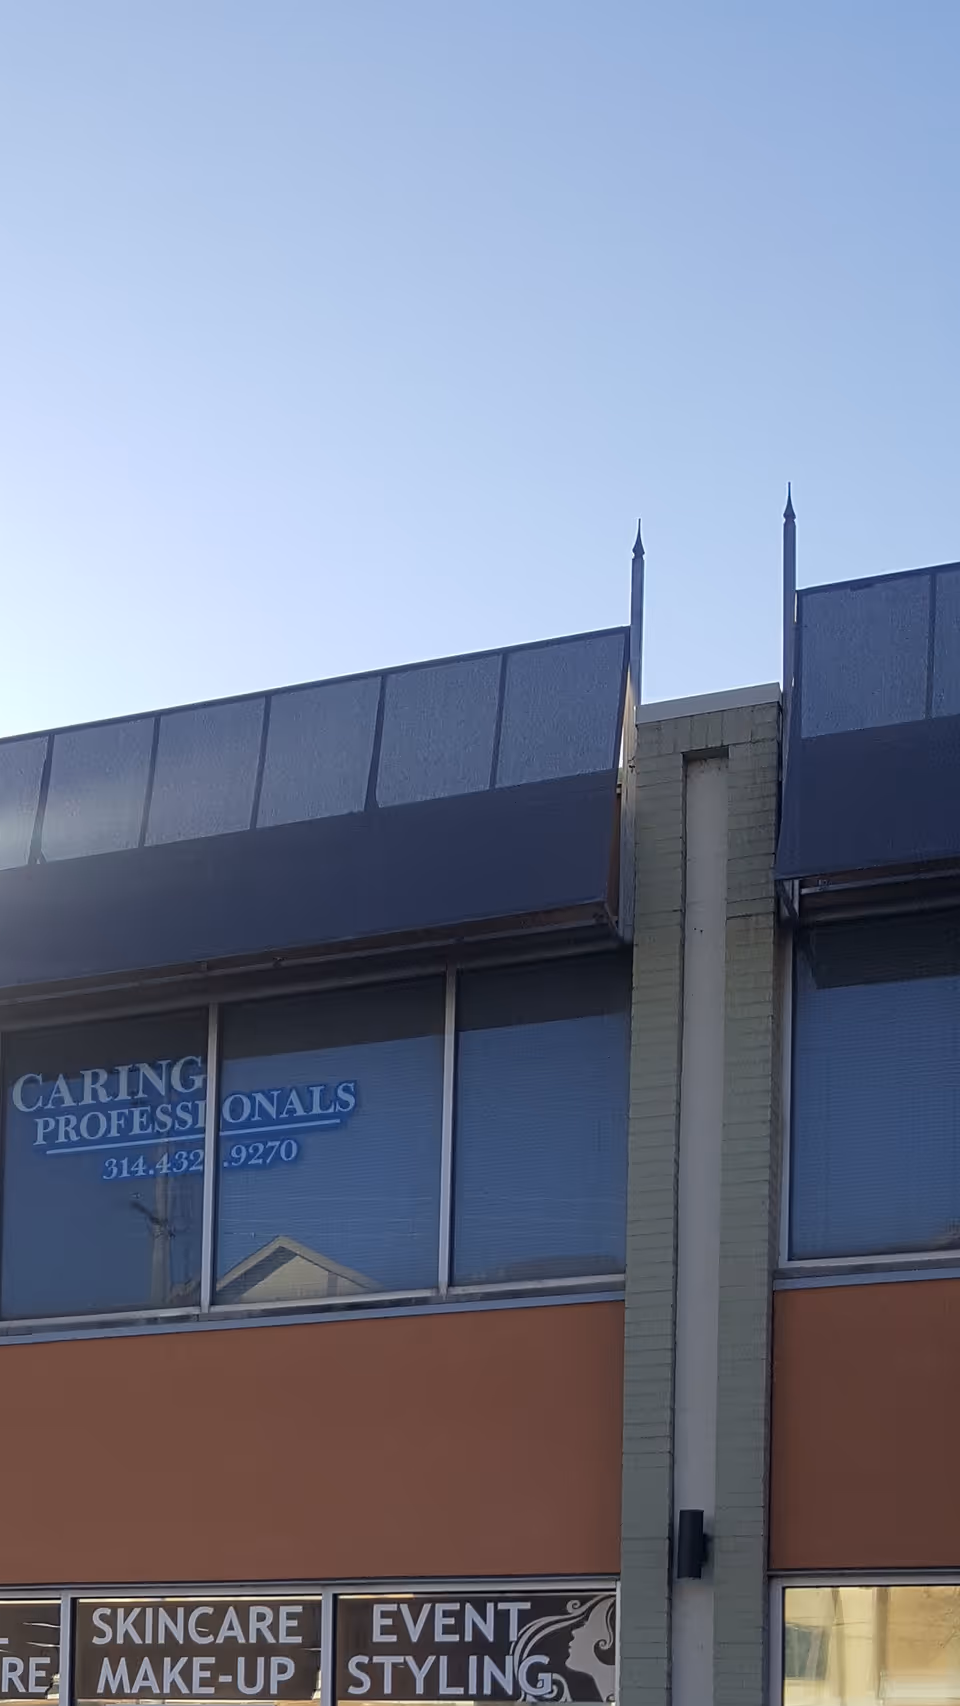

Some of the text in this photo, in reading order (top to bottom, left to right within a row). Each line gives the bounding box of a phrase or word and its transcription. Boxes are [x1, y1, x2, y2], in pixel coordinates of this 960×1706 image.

[12, 1055, 206, 1113] CARING
[32, 1082, 357, 1146] PROFESSIONALS
[102, 1139, 298, 1180] 314.432.9270
[91, 1605, 304, 1645] SKINCARE
[371, 1601, 531, 1643] EVENT
[96, 1655, 296, 1695] MAKE-UP
[347, 1654, 553, 1696] STYLING
